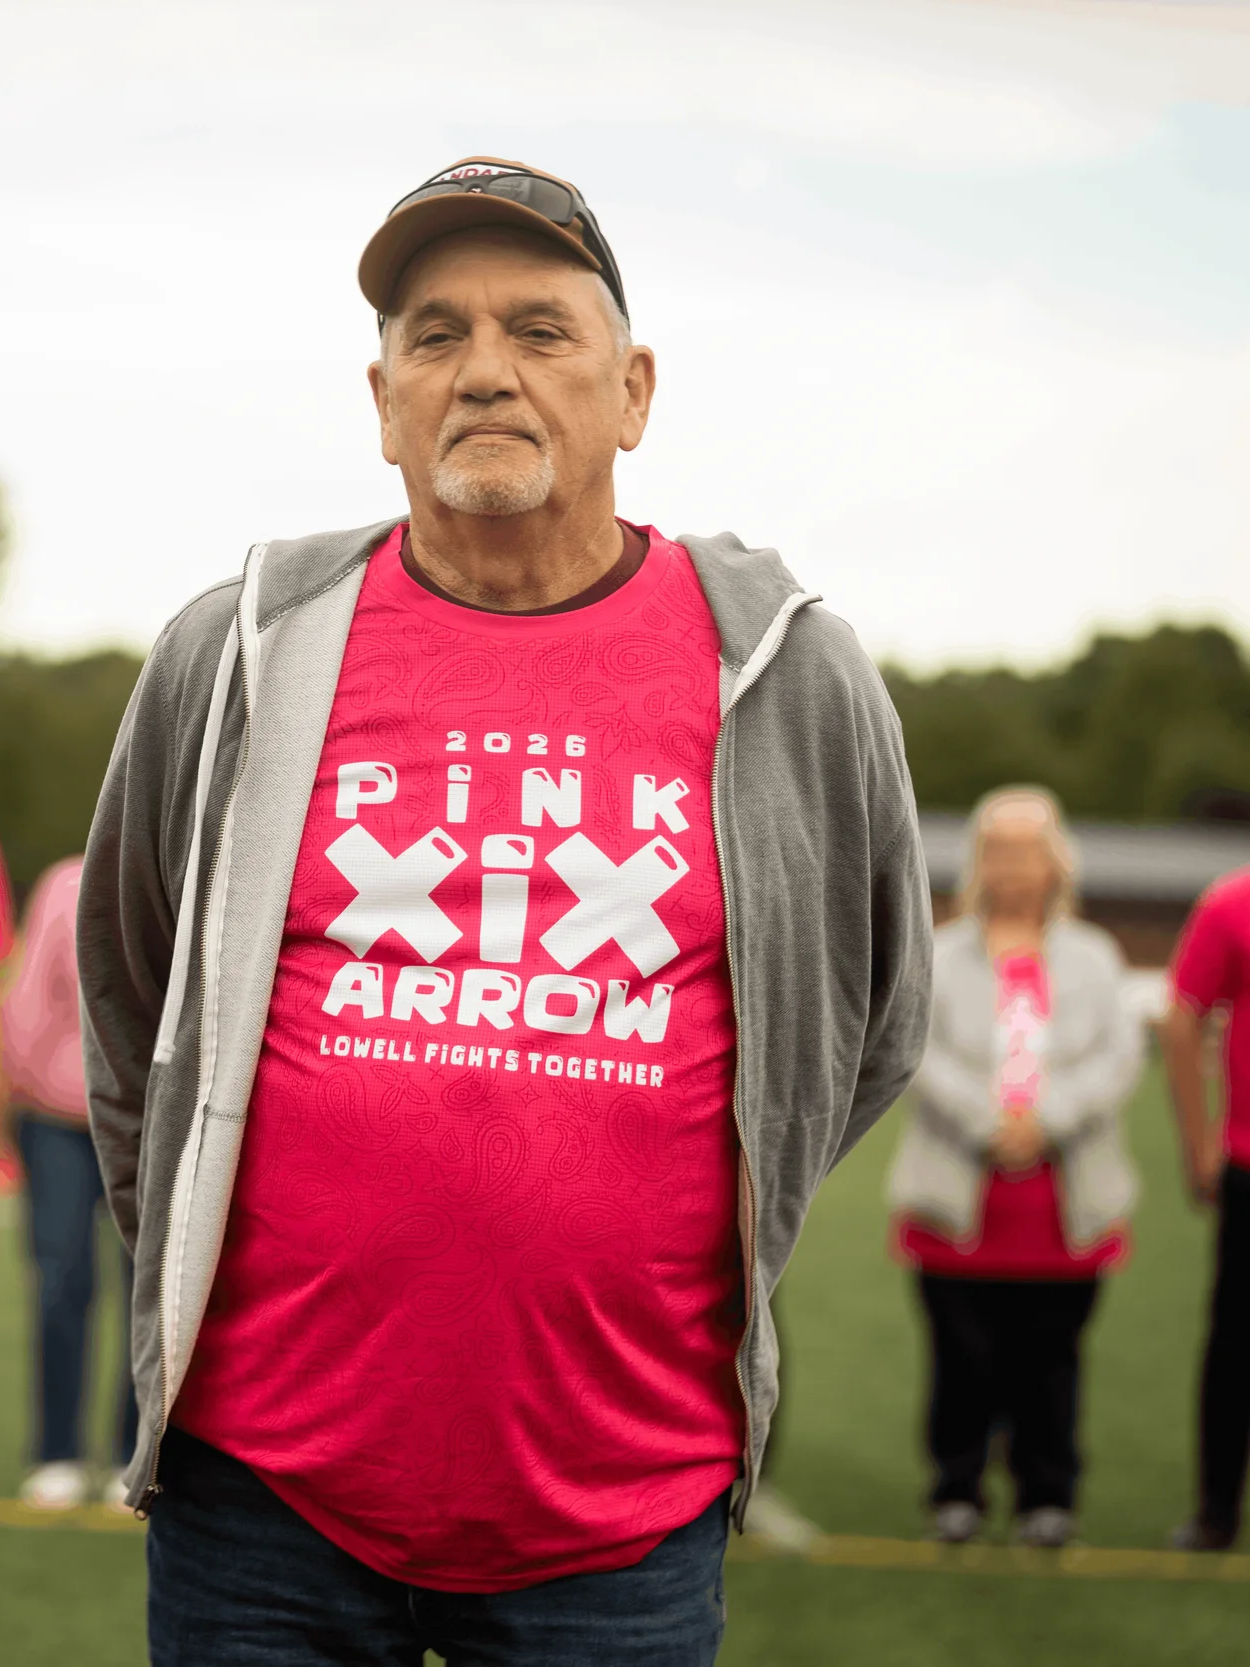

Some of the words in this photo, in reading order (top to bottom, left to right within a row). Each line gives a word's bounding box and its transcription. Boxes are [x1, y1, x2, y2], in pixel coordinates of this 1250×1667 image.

[445, 730, 586, 757] 2026
[321, 961, 675, 1043] ARROW
[320, 1035, 416, 1062] LOWELL
[528, 1052, 664, 1088] TOGETHER
